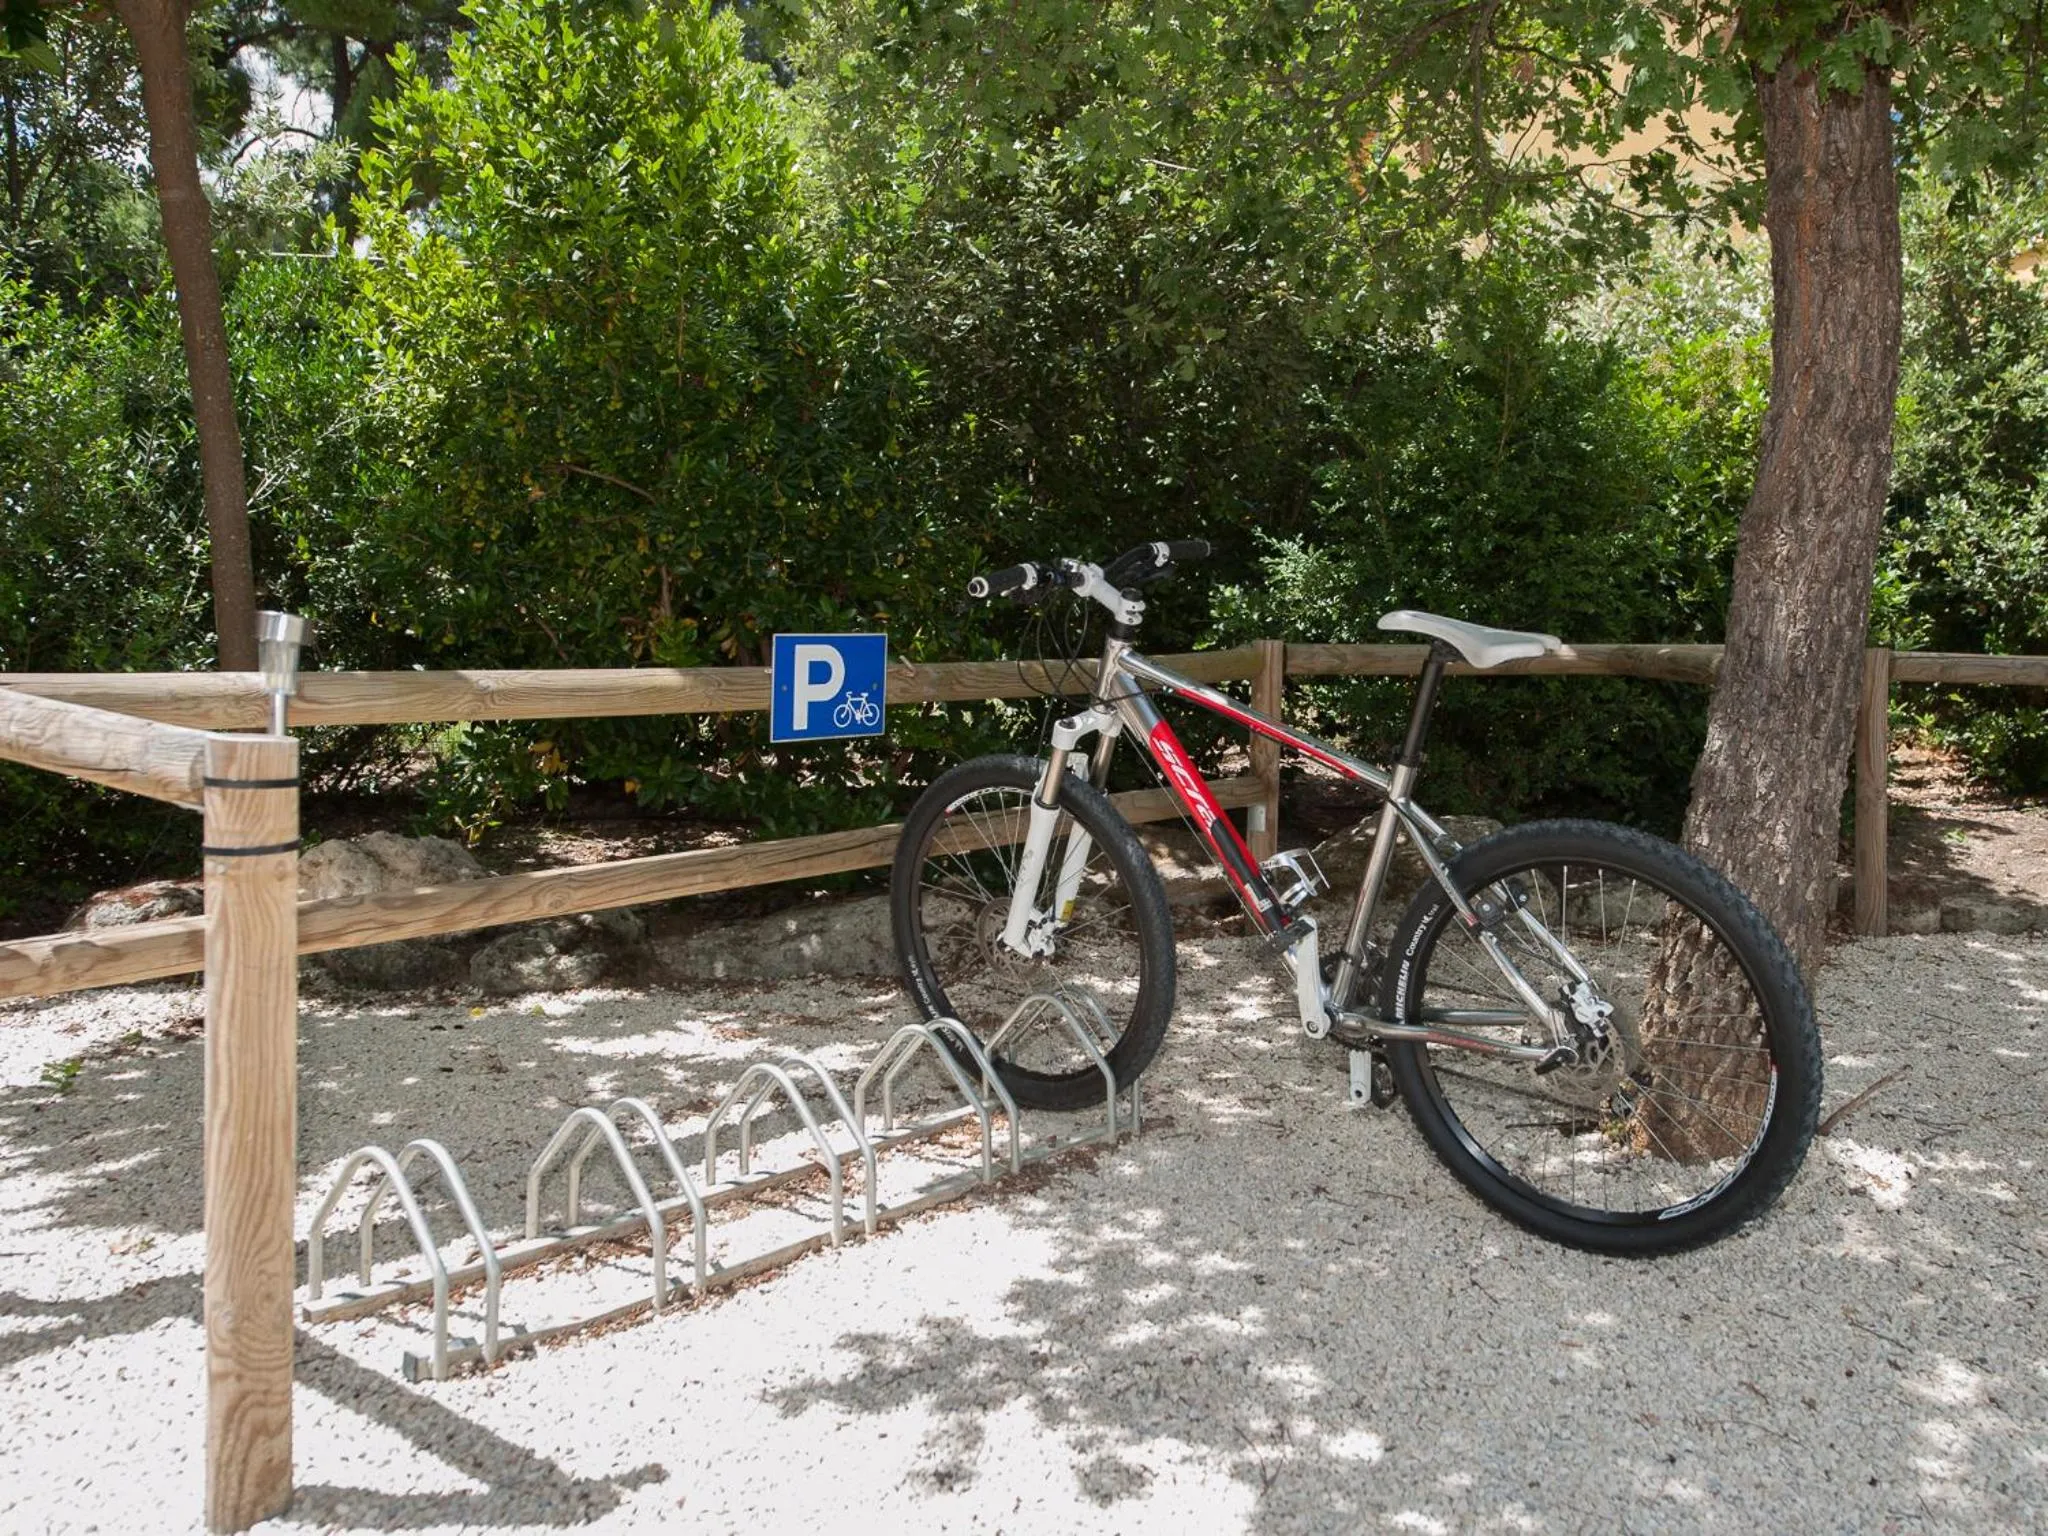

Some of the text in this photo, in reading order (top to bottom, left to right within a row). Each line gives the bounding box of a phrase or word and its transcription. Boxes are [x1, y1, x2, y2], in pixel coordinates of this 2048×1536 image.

[793, 644, 845, 731] P
[1395, 960, 1410, 1019] MICHELIN
[1405, 923, 1427, 956] Country
